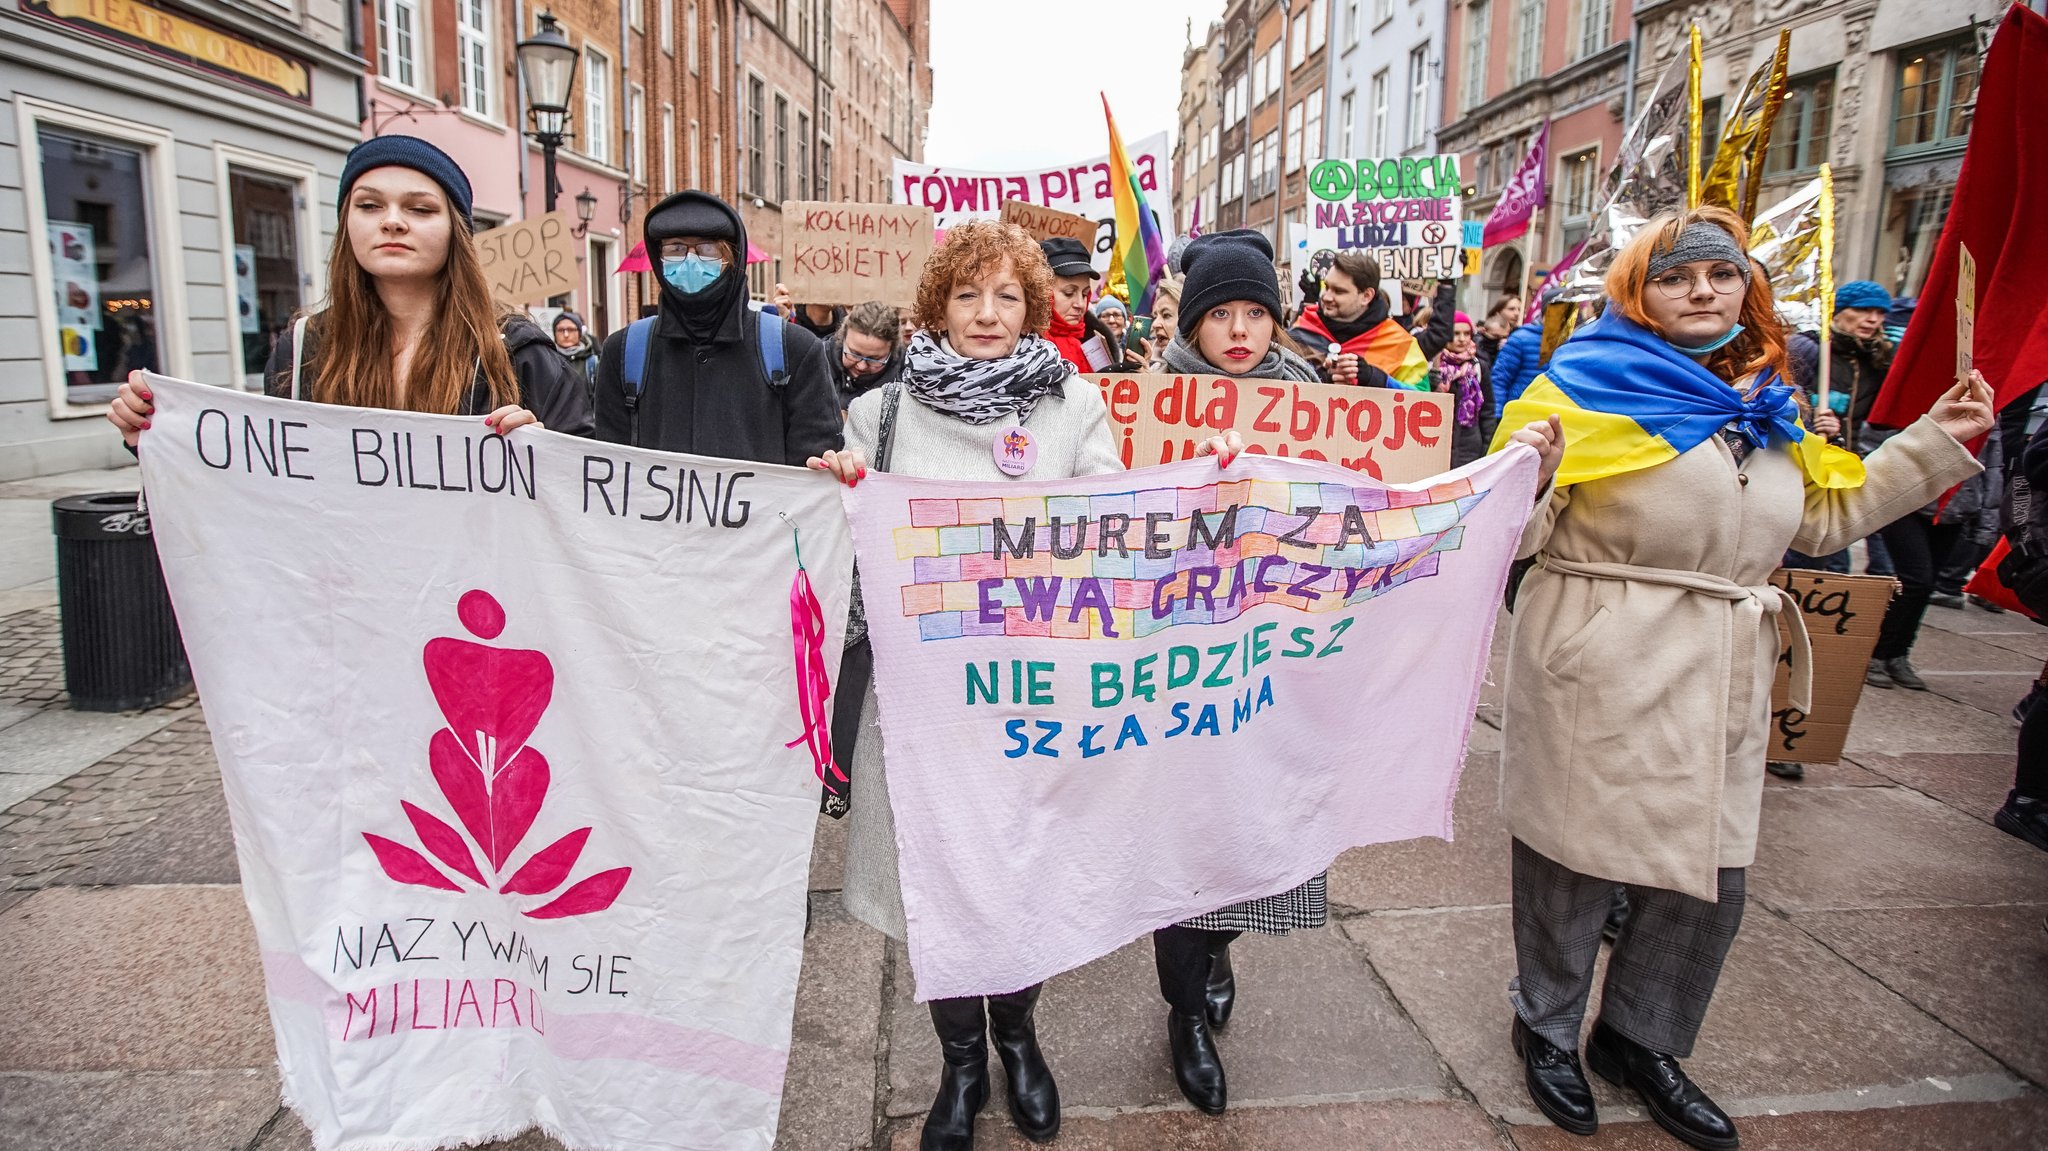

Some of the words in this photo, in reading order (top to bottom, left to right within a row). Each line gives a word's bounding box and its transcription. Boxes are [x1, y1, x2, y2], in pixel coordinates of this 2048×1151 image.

[207, 36, 281, 81] OKNIE
[903, 167, 1031, 214] równa
[1039, 153, 1158, 207] praa
[1309, 155, 1462, 202] ABORCJA
[480, 218, 560, 267] STOP
[804, 209, 919, 238] KOCHAMY
[1315, 202, 1350, 229] NA
[1337, 222, 1408, 249] LUDZI
[1153, 375, 1239, 432] dla
[195, 408, 315, 481] ONE
[351, 427, 536, 501] BILLION
[583, 455, 755, 529] RISING
[992, 503, 1239, 561] MUREM
[1276, 504, 1376, 551] ZA
[977, 575, 1120, 639] EWĄ
[965, 659, 1056, 706] NIE
[1090, 616, 1355, 708] BĘDZIESZ
[1164, 674, 1275, 739] SAMA
[566, 954, 632, 998] SIĘ
[343, 978, 545, 1041] MILIARD
